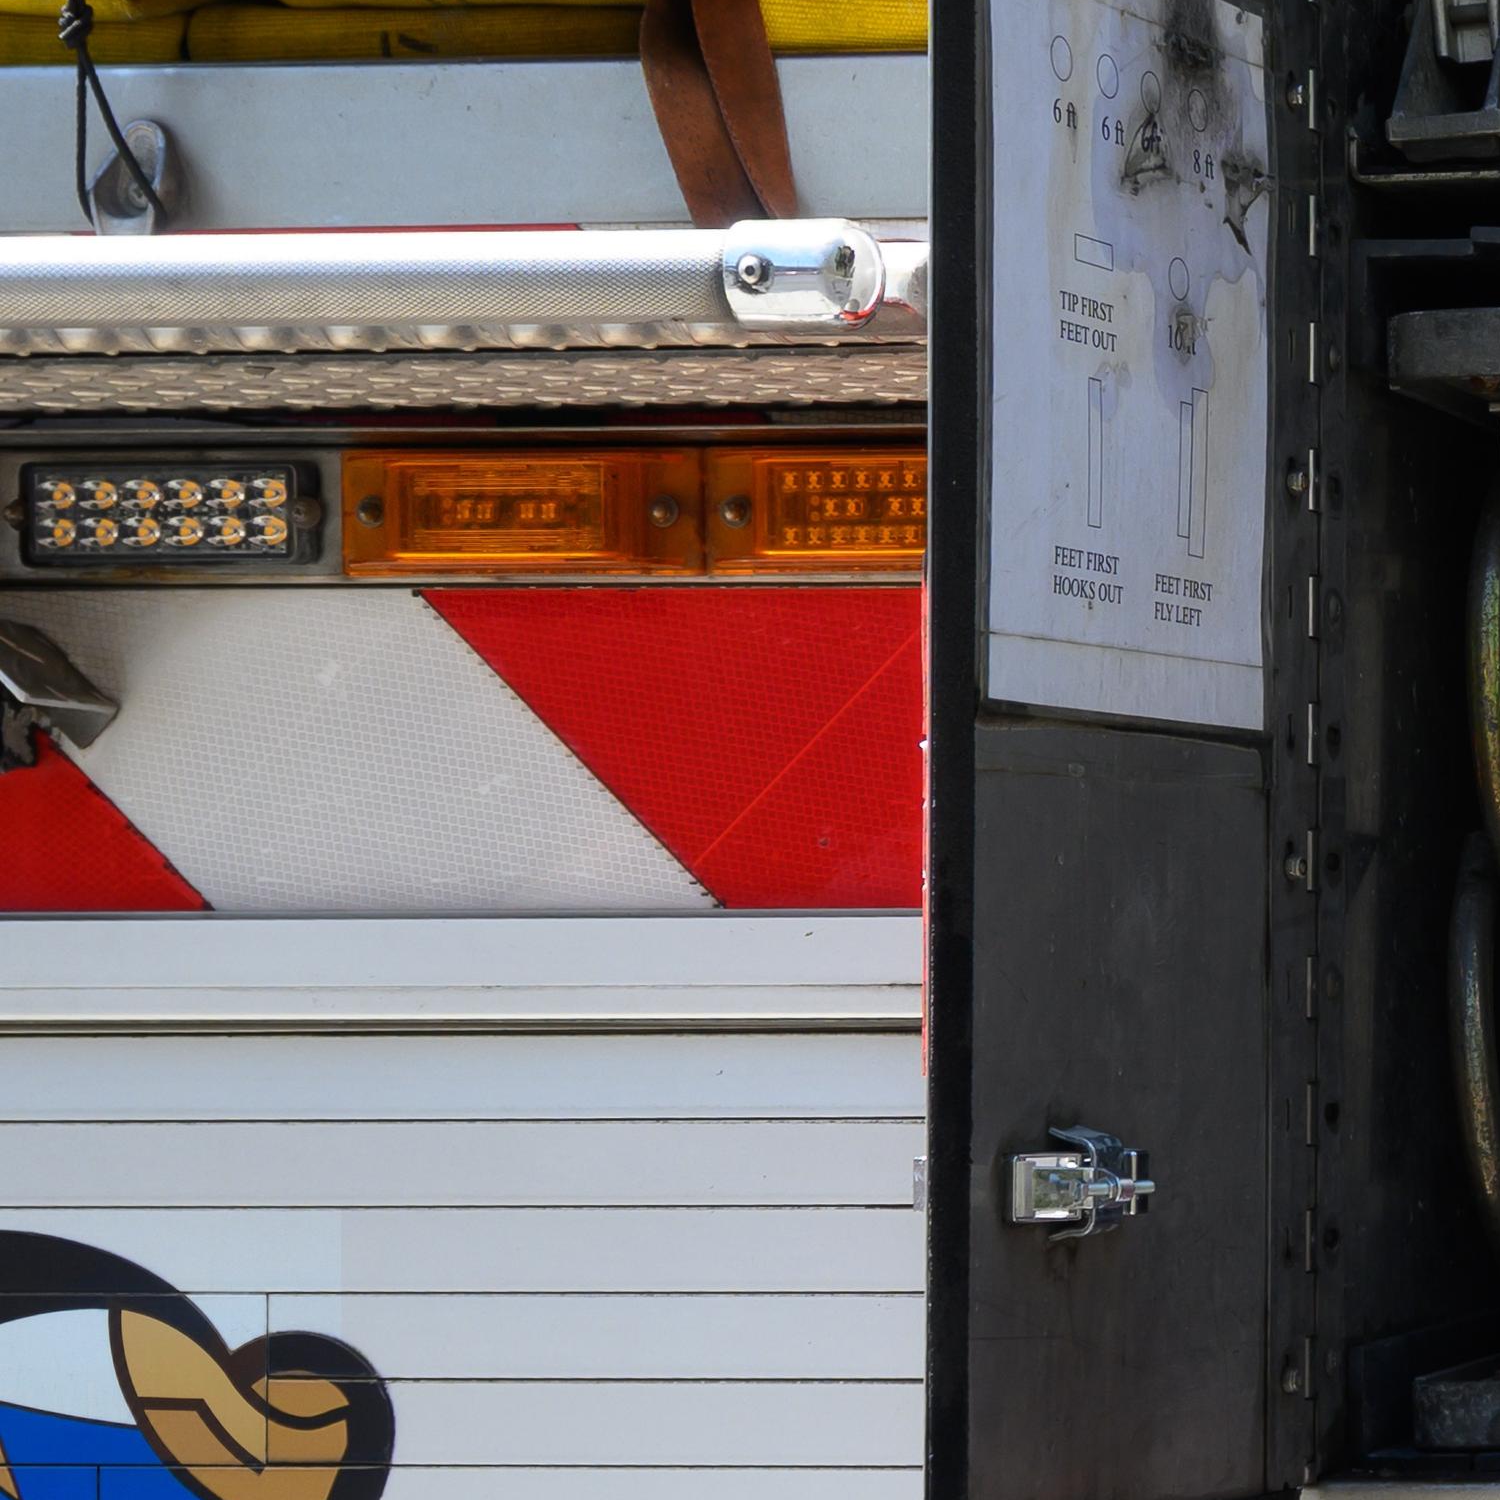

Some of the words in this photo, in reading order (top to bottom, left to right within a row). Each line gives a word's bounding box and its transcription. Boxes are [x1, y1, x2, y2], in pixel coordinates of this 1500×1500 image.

[1053, 98, 1062, 123] 6
[1066, 102, 1077, 129] ft
[1102, 116, 1110, 140] 6
[1114, 120, 1125, 147] ft
[1193, 150, 1202, 175] 8
[1205, 154, 1215, 180] ft
[1059, 290, 1079, 313] TIP
[1081, 297, 1114, 322] FIRST
[1059, 320, 1090, 346] FEET
[1092, 329, 1117, 352] OUT
[1054, 545, 1084, 569] FEET
[1086, 552, 1120, 575] FIRST
[1053, 575, 1096, 600] HOOKS
[1098, 582, 1124, 604] OUT
[1155, 573, 1181, 596] FEET
[1183, 579, 1213, 602] FIRST
[1154, 602, 1174, 622] FLY
[1176, 606, 1202, 626] LEFT
